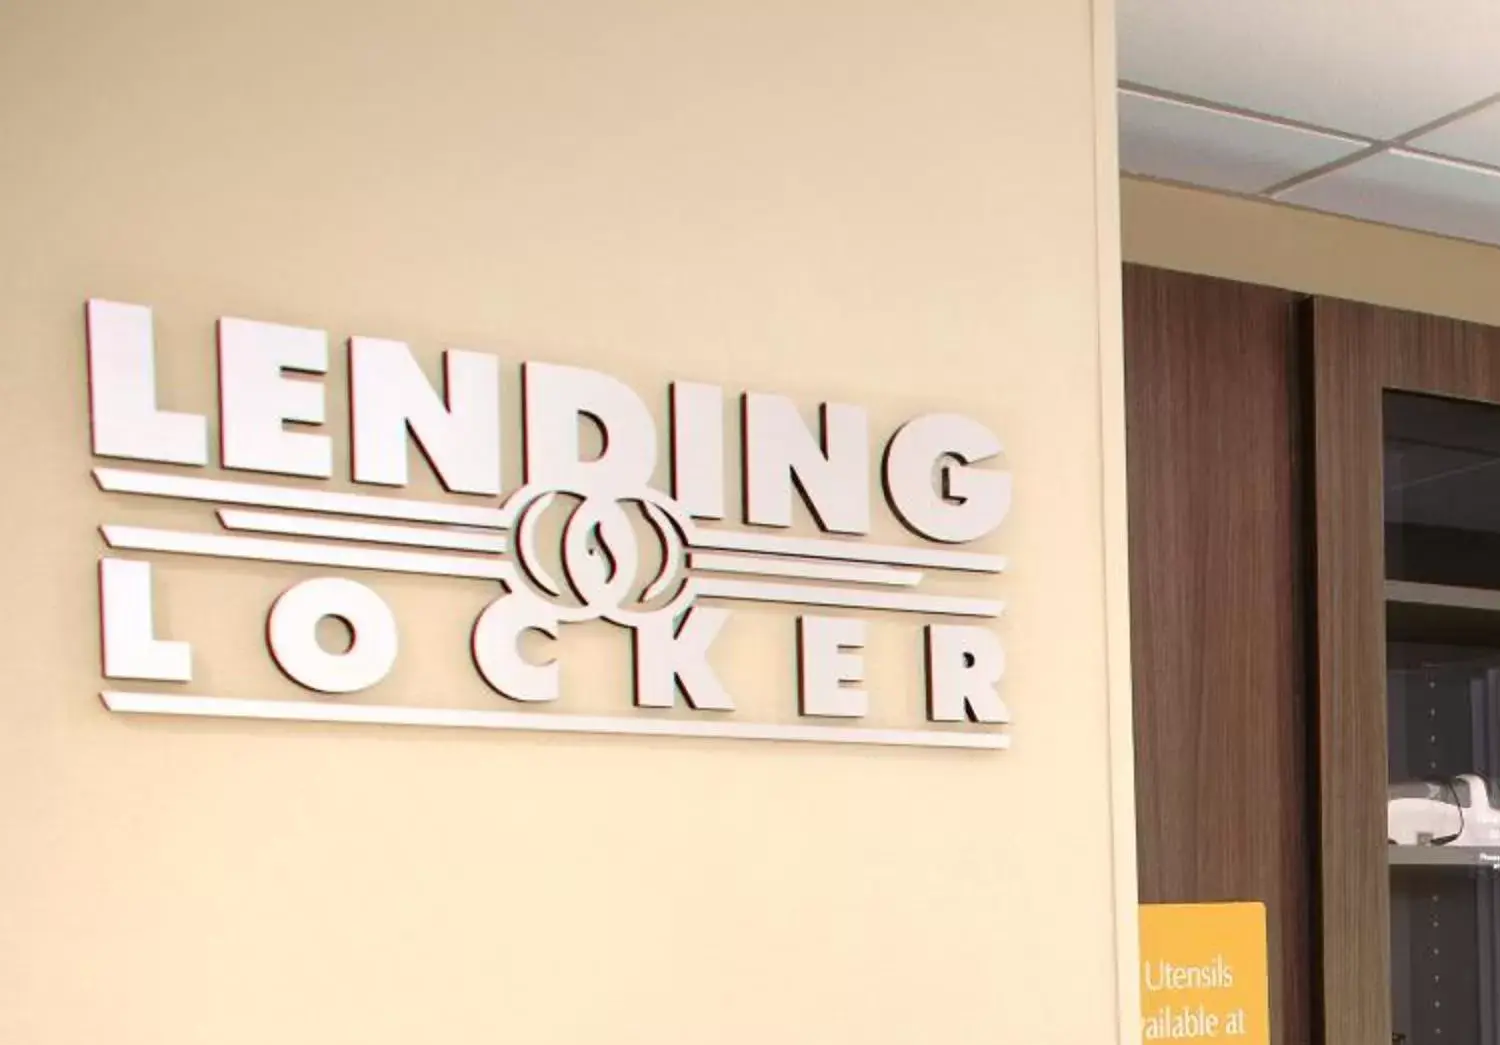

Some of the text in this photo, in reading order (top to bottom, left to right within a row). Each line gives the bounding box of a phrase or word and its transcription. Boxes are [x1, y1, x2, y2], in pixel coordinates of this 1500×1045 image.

[87, 298, 1012, 544] LENDING
[98, 555, 1010, 723] LOCKER
[1144, 953, 1234, 992] Utensils
[1225, 1008, 1247, 1036] at
